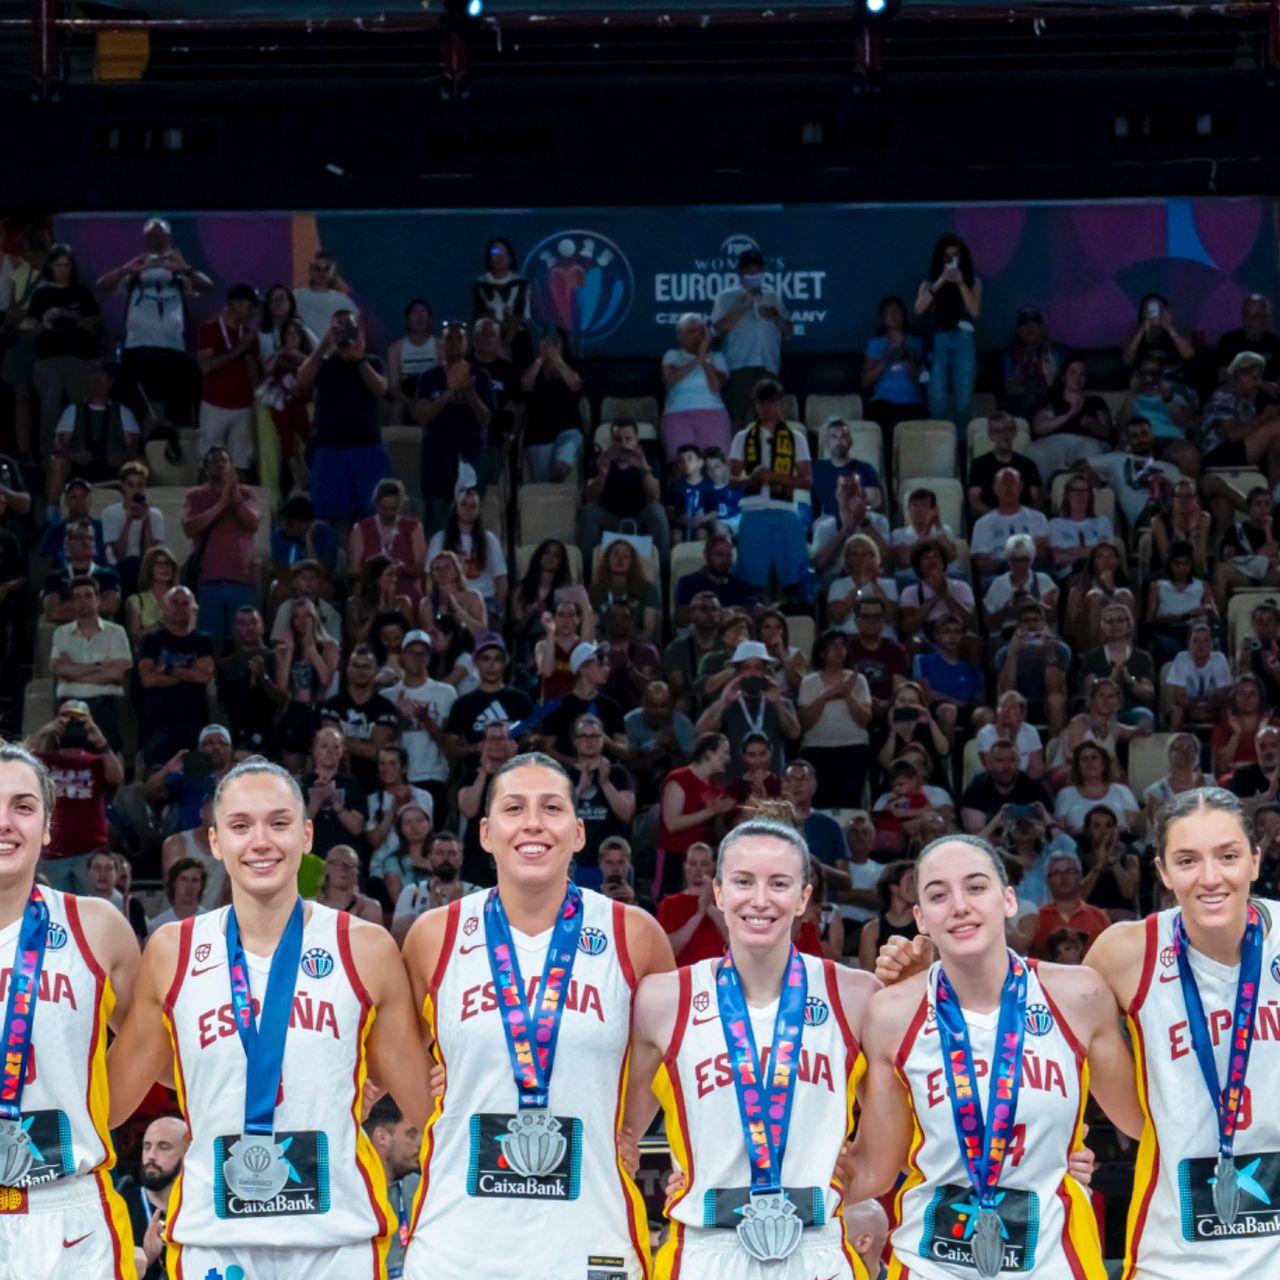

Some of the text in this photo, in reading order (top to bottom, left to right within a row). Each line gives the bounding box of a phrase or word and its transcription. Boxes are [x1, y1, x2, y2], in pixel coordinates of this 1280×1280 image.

[198, 991, 340, 1049] ESÑA
[479, 1175, 566, 1197] CaixaBank
[228, 1193, 315, 1214] CaixaBank
[932, 1241, 1020, 1268] Caixank
